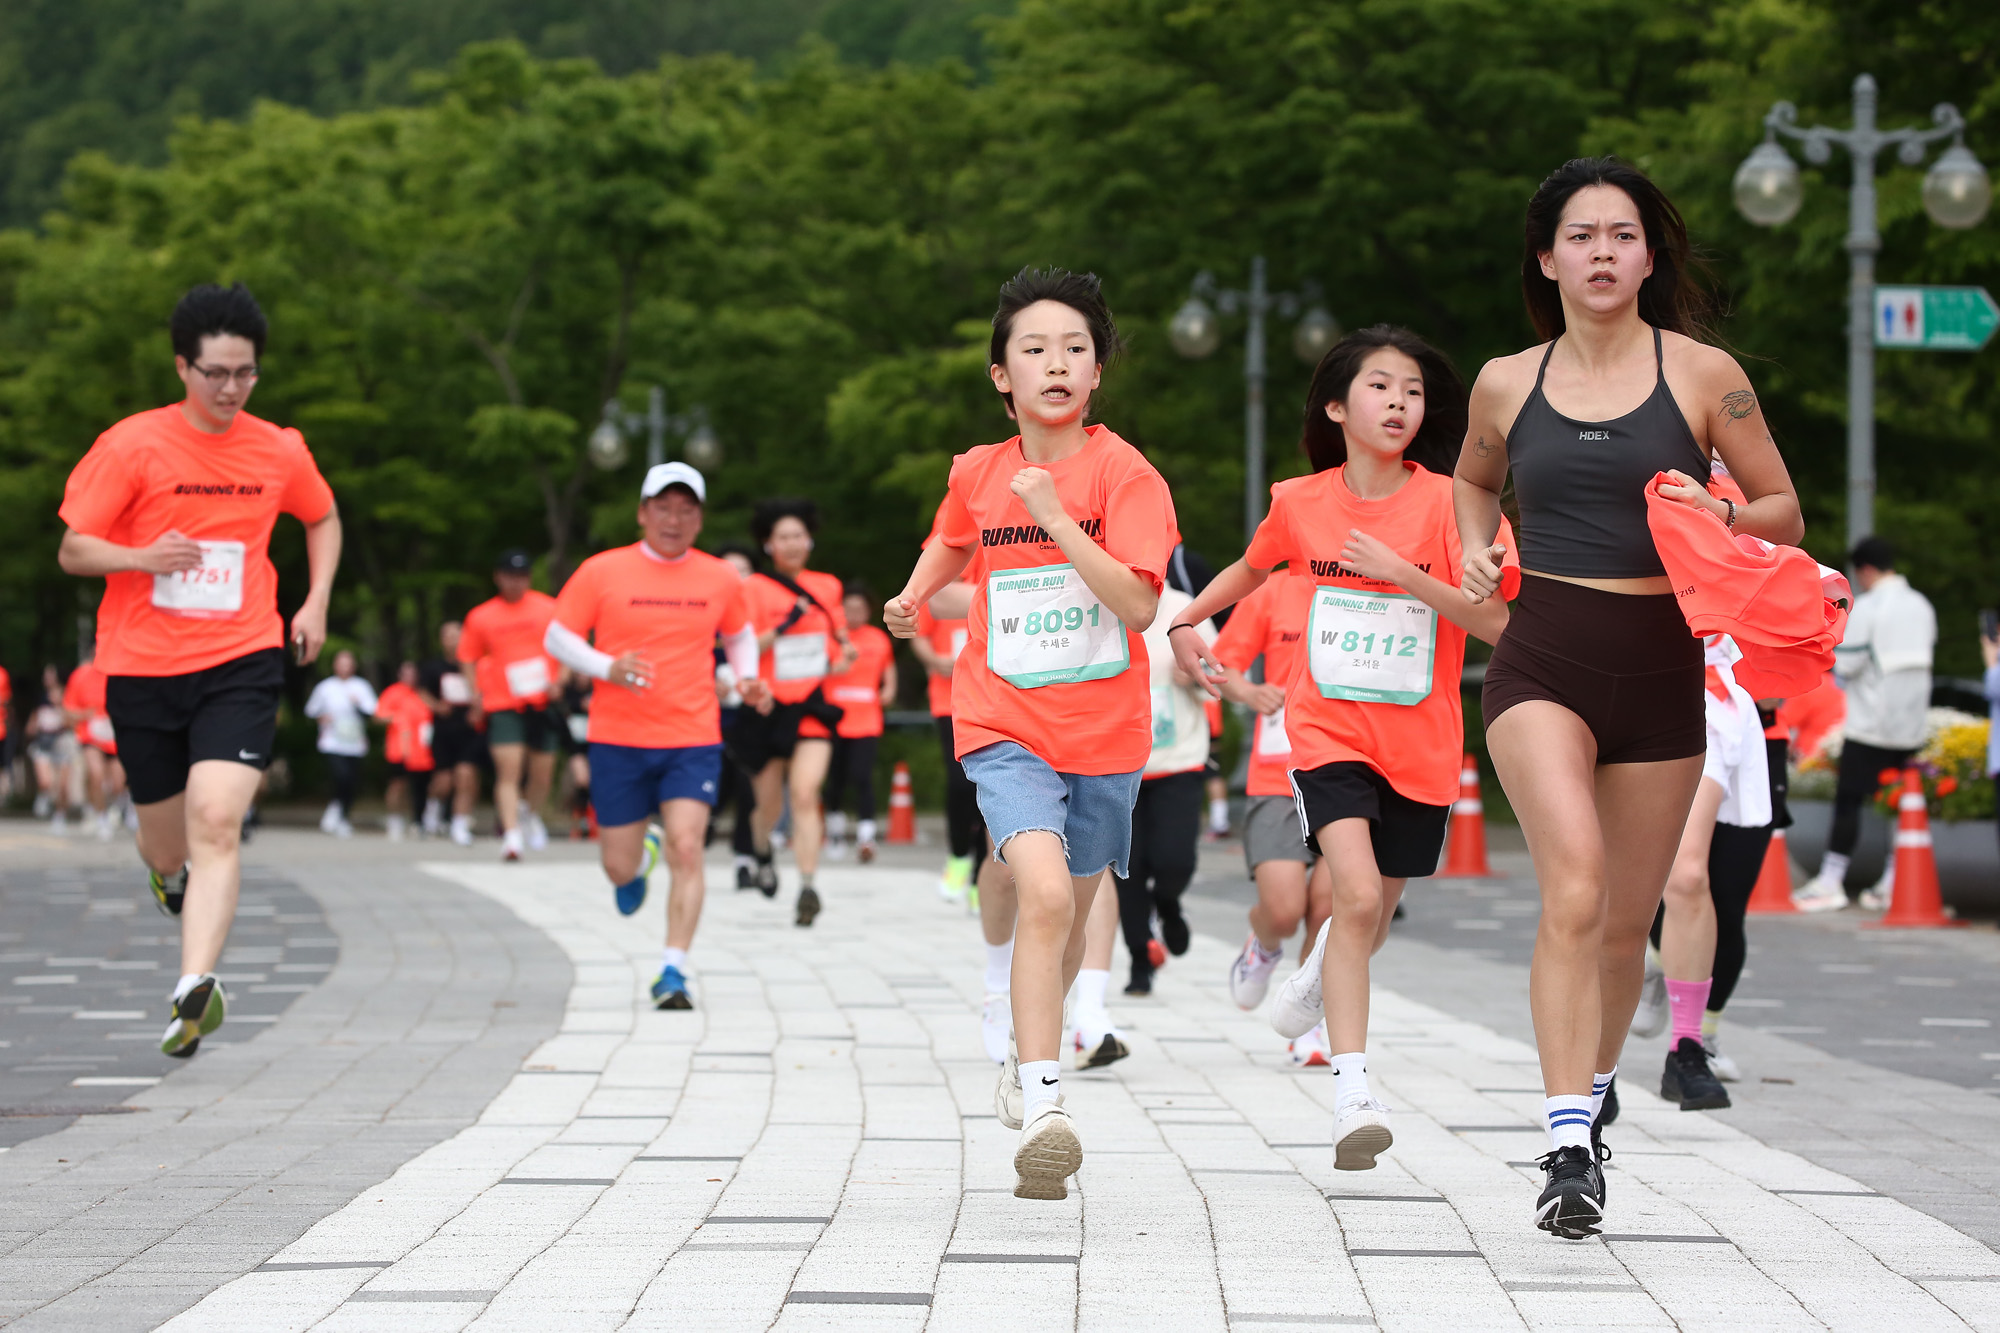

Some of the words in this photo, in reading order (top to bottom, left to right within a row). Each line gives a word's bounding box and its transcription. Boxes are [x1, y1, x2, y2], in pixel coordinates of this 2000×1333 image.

[1579, 430, 1610, 440] HDEX
[174, 484, 235, 495] BURNING
[237, 484, 263, 495] RUN
[982, 526, 1055, 547] BURNIN
[996, 577, 1040, 592] BURNING
[1042, 575, 1066, 587] RUN
[1322, 596, 1364, 610] BURNING
[1365, 601, 1390, 612] RUN
[1406, 606, 1426, 615] 7km
[1001, 617, 1020, 634] W
[1024, 603, 1100, 636] 8091
[1040, 637, 1070, 650] 추세은
[1321, 630, 1338, 645] W
[1341, 630, 1418, 657] 8112
